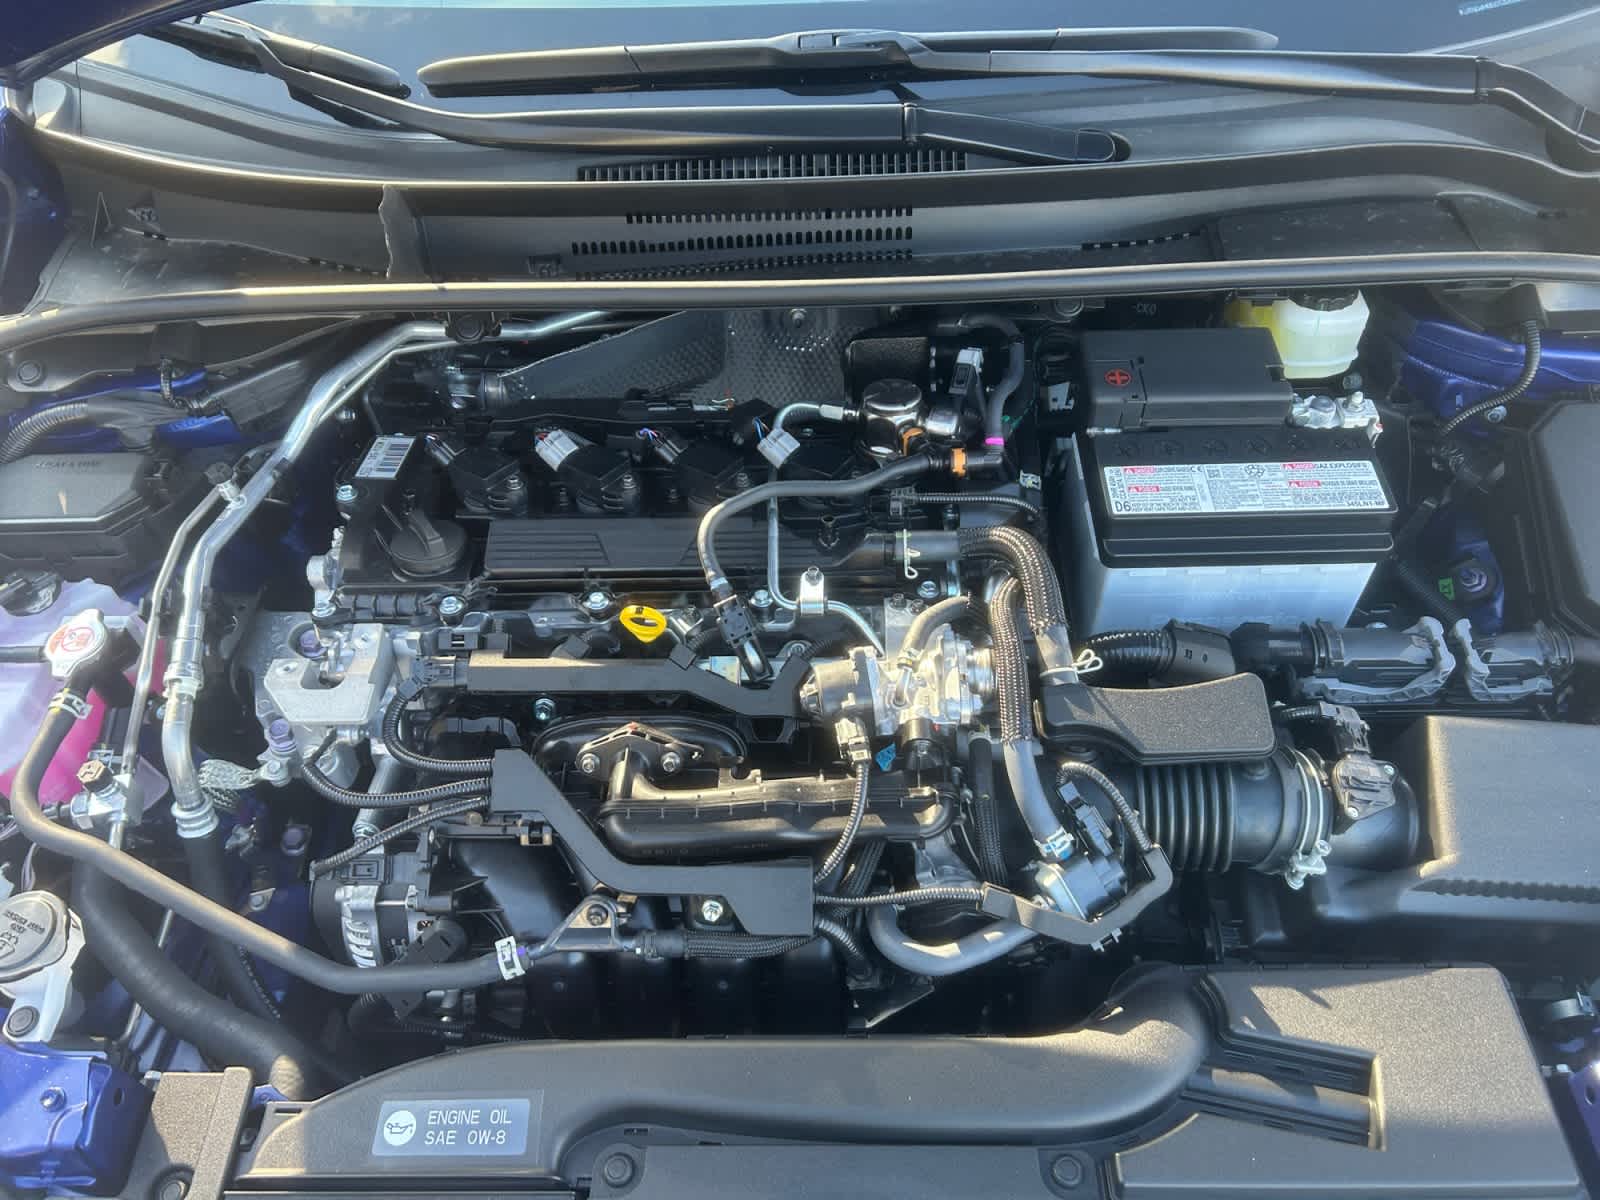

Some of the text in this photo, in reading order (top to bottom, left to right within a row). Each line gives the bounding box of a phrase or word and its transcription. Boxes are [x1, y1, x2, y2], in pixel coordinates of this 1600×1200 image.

[1115, 501, 1131, 512] D6
[427, 1109, 512, 1125] ENGINE OIL
[424, 1130, 506, 1145] SAE 0W-8
